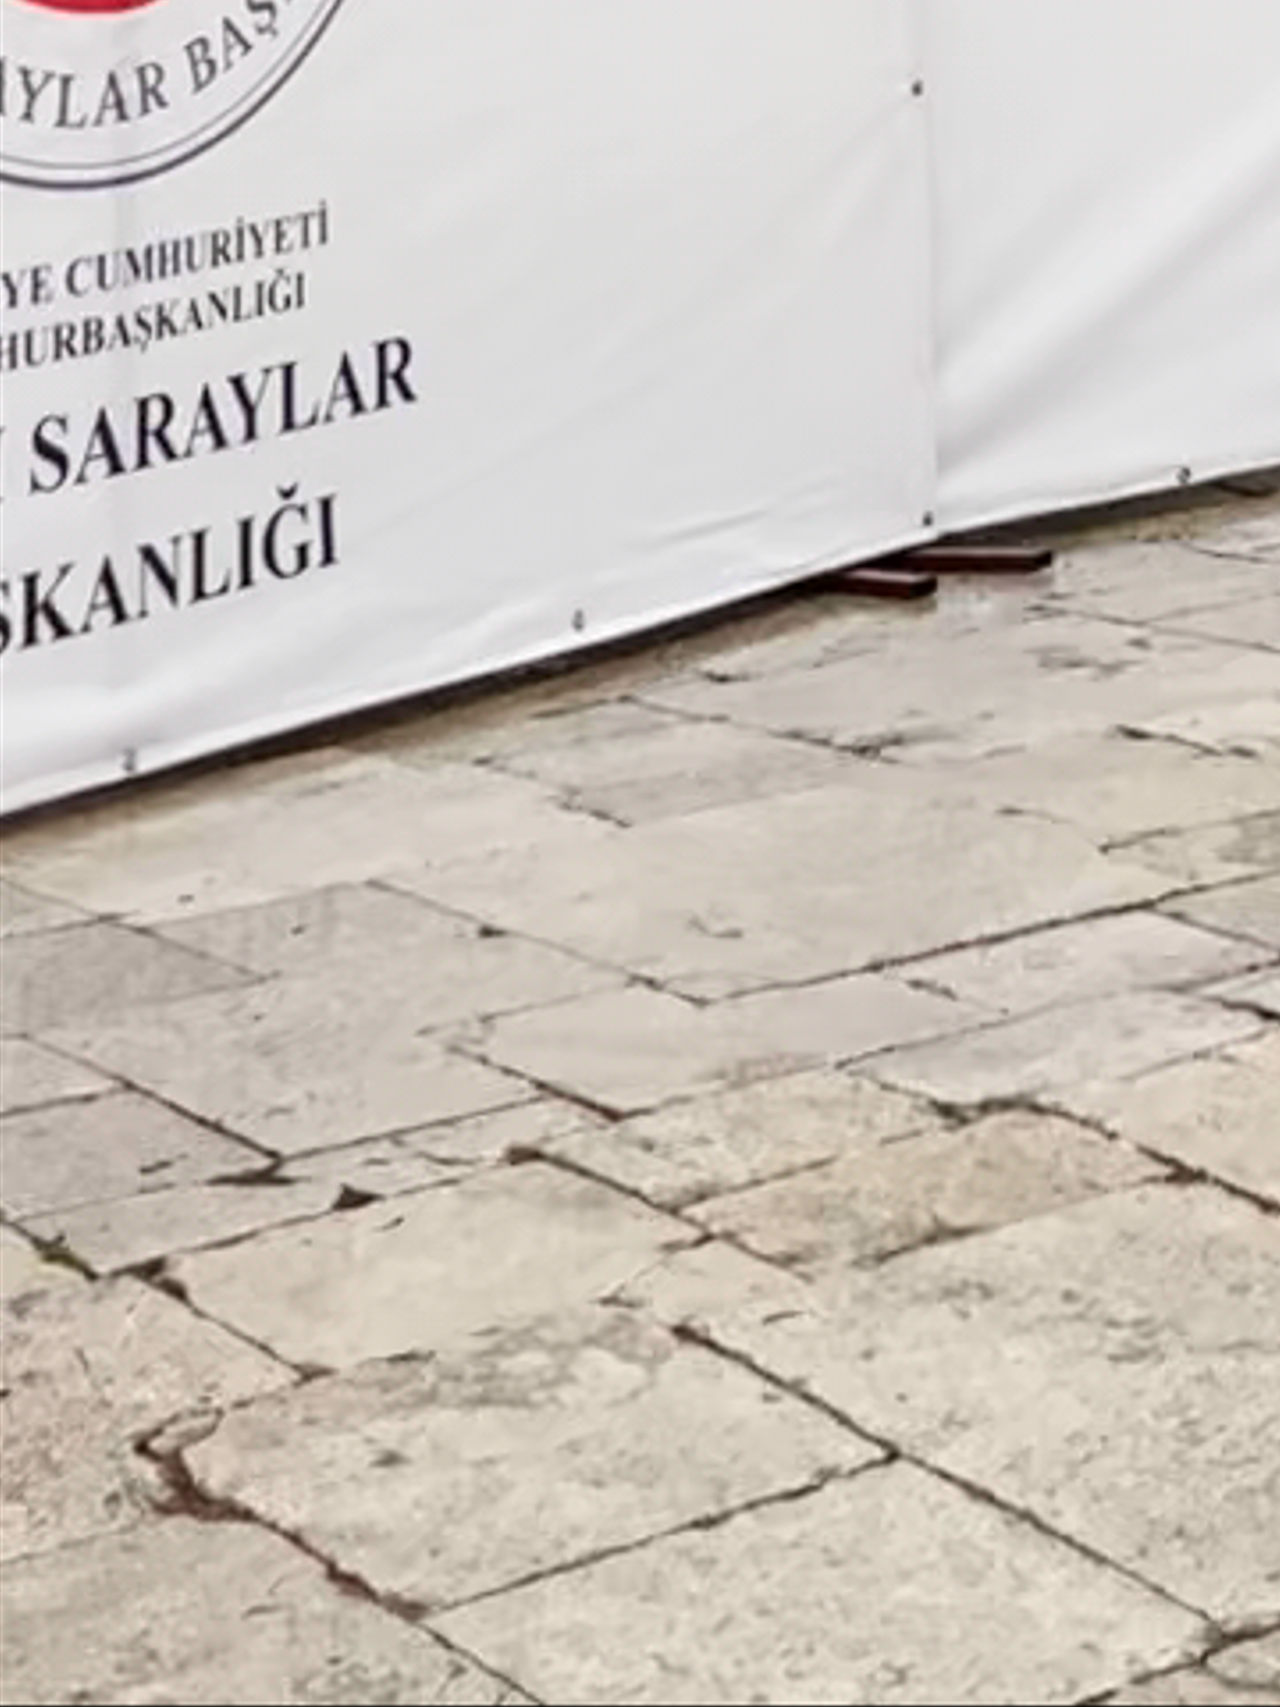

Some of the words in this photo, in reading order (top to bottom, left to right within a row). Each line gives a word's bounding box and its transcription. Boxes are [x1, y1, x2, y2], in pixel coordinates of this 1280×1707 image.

[0, 54, 170, 131] YLAR
[65, 199, 329, 298] CUMHURİYETİ
[28, 335, 417, 496] SARAYLAR
